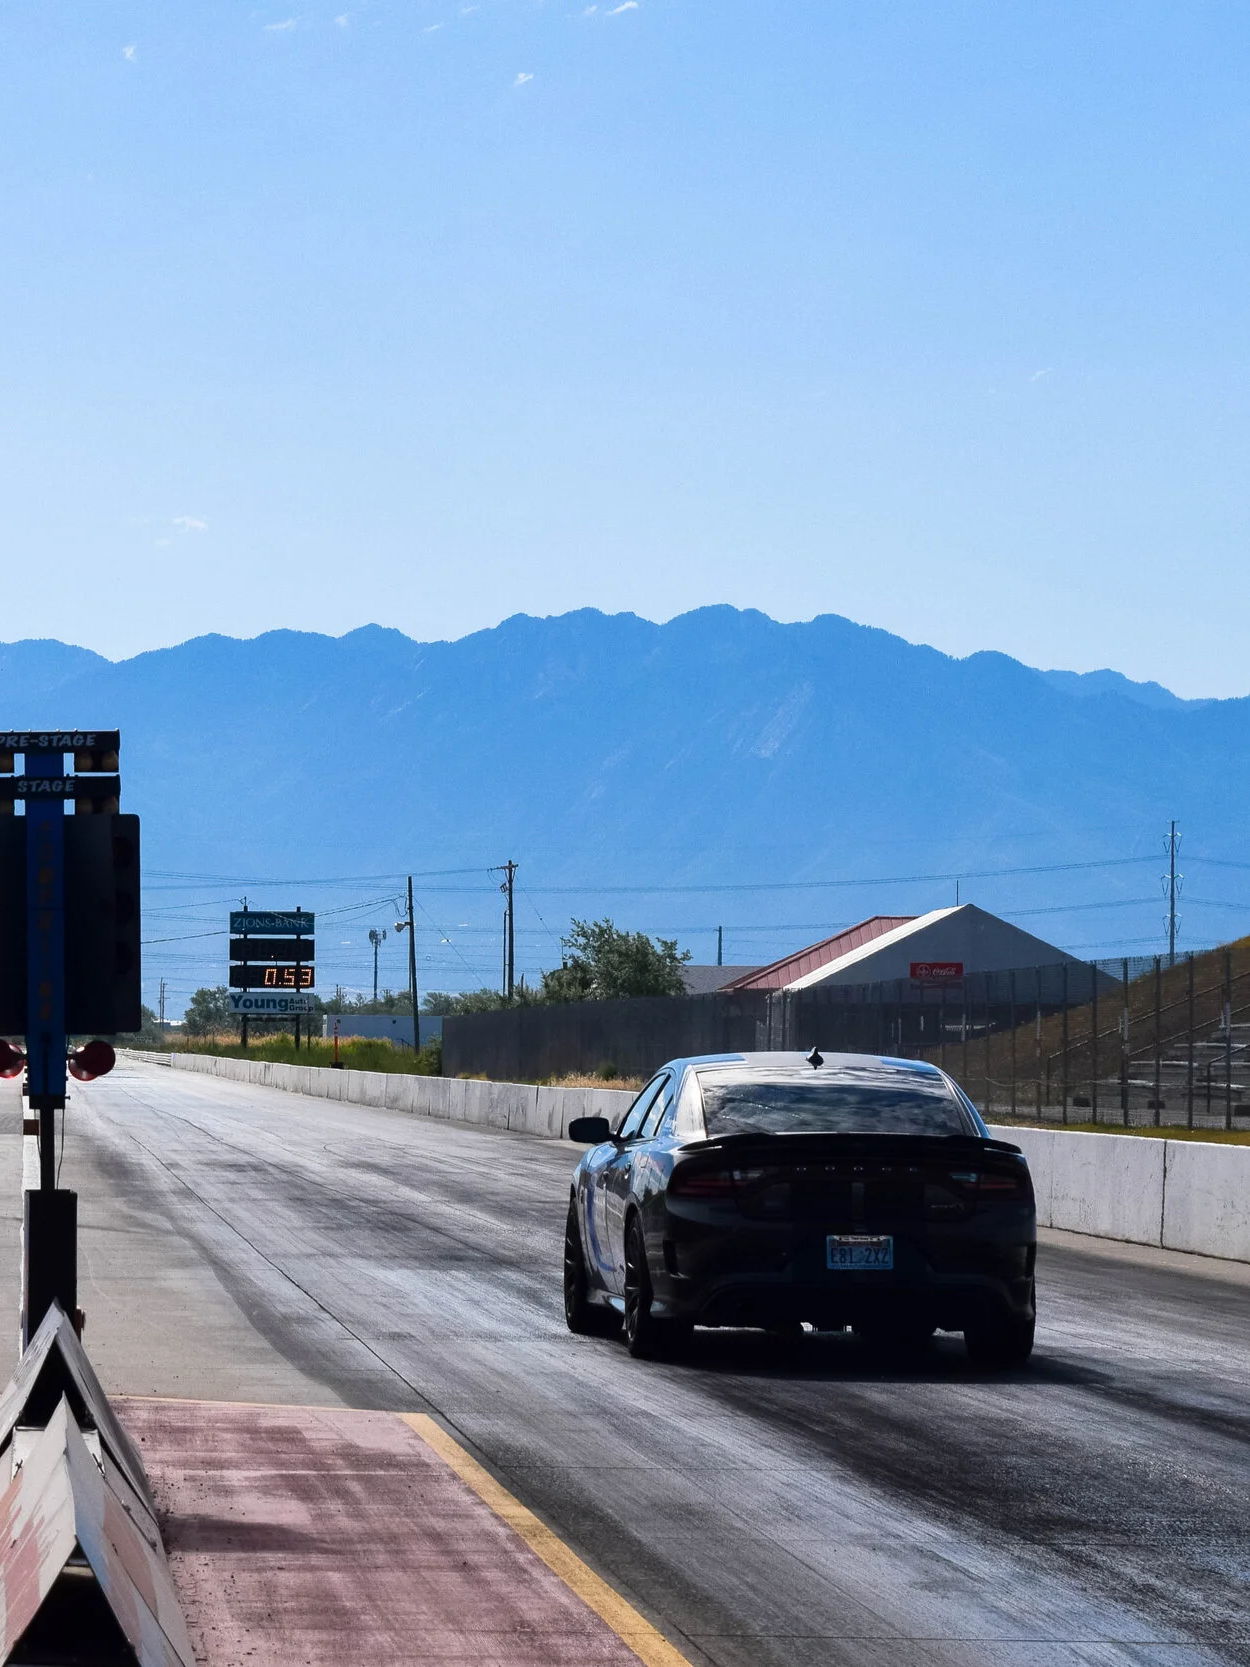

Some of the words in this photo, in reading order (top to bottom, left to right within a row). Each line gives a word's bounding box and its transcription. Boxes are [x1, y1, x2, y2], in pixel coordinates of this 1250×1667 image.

[17, 780, 76, 793] STAGE
[233, 917, 271, 928] ZIONS
[275, 917, 309, 928] BANK
[264, 968, 312, 985] 0.53
[230, 995, 289, 1011] Young
